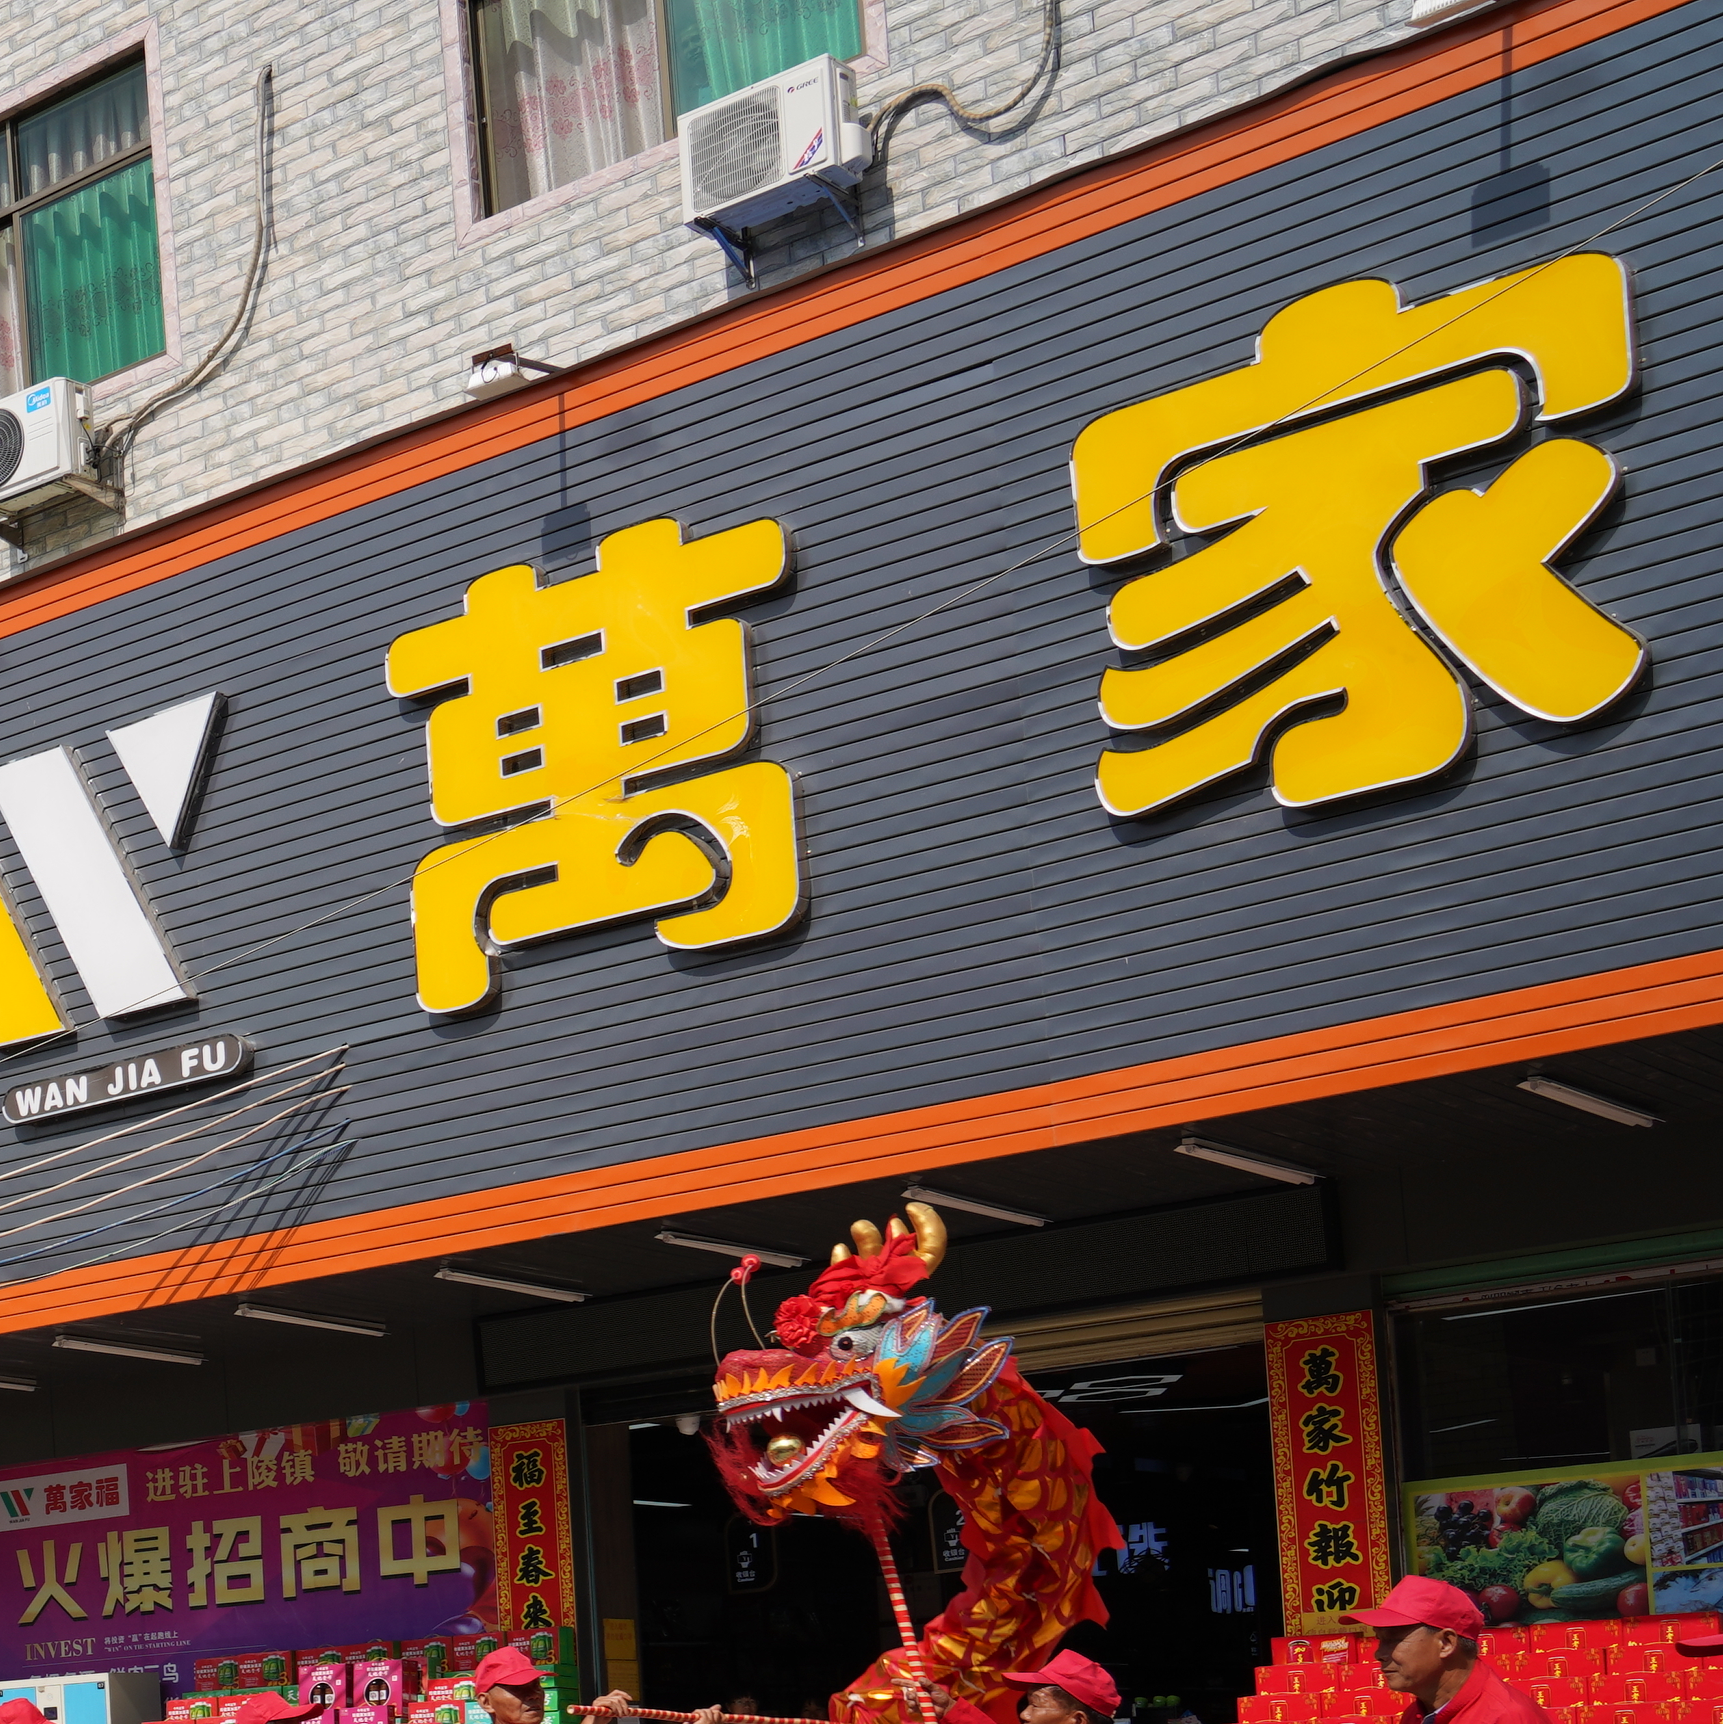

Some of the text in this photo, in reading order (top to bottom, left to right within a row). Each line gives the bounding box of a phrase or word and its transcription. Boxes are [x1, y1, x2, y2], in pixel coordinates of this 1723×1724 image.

[796, 76, 818, 91] GREE
[15, 1041, 226, 1117] WAN JIA FU
[144, 1426, 485, 1503] 进驻上陵镇 敬请期待
[44, 1477, 120, 1515] 萬家福
[16, 1494, 462, 1626] 火爆招商中
[25, 1637, 96, 1661] INVEST
